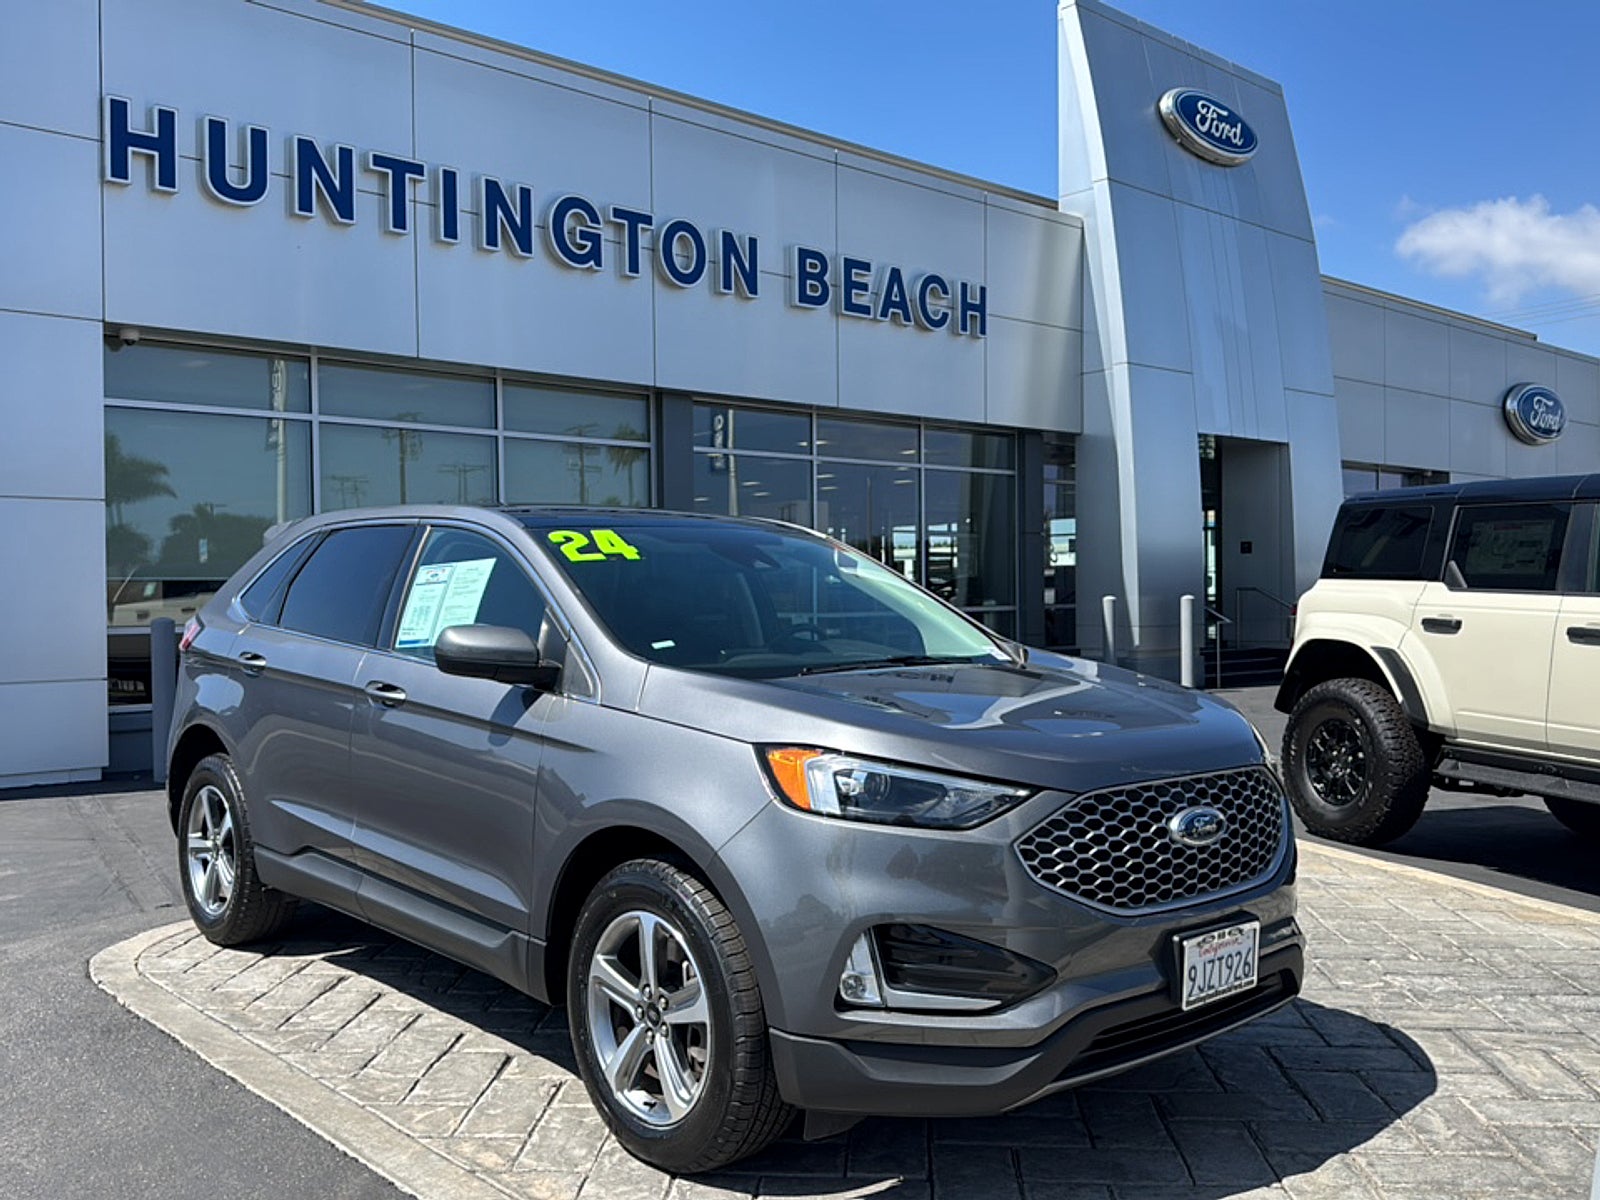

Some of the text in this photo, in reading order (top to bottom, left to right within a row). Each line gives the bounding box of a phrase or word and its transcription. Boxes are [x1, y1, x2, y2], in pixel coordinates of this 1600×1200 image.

[1195, 100, 1244, 146] Ford
[104, 96, 988, 338] HUNTINGTON BEACH
[1530, 396, 1562, 430] Ford
[548, 529, 641, 562] 24
[1187, 947, 1252, 998] 9JZT926
